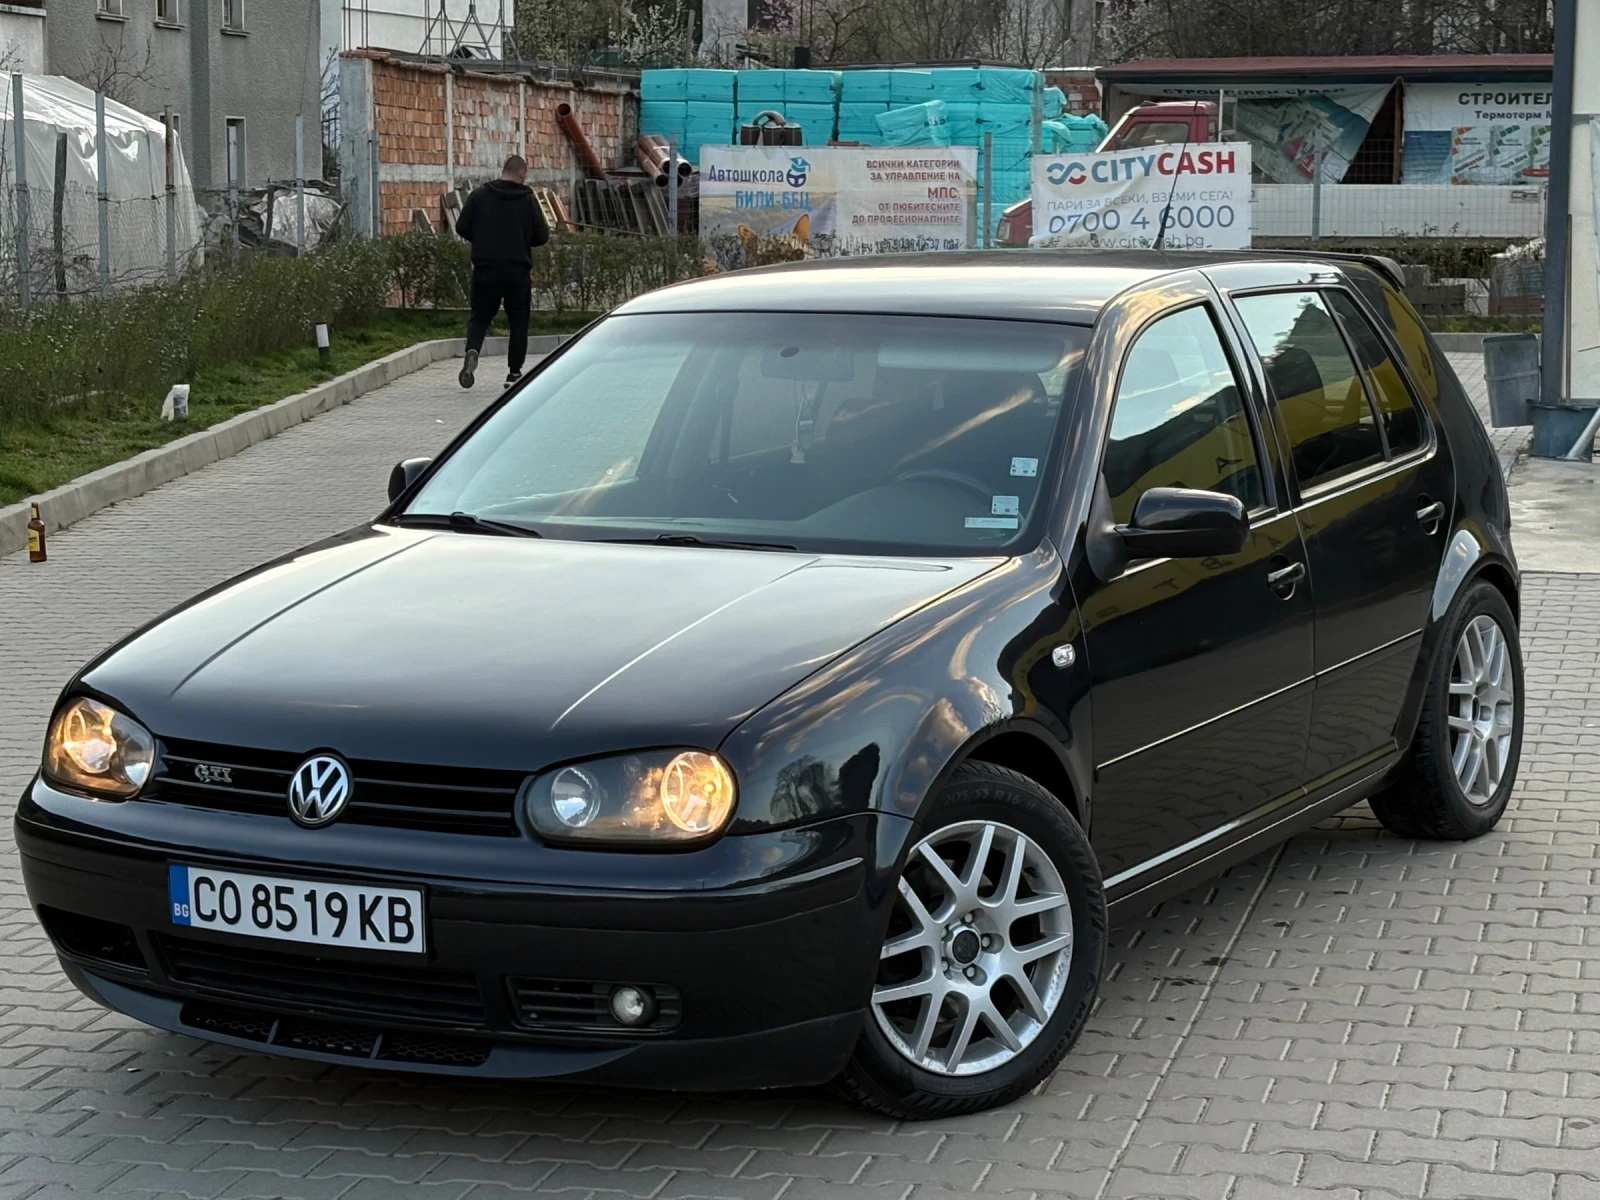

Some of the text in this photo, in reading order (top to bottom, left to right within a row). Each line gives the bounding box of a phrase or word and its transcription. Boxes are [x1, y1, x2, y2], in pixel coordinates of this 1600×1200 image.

[1474, 110, 1542, 121] Термотерм
[708, 164, 784, 183] Автошкола
[866, 160, 960, 169] ВСИЧКИ КАТЕГОРИИ
[1091, 151, 1235, 183] CITYCASH
[870, 171, 960, 181] ЗА УПРАВЛЕНИЕ НА
[878, 203, 890, 211] ОТ
[1047, 201, 1082, 211] ПАРИ
[1086, 199, 1100, 209] ЗА
[1104, 193, 1149, 208] ВСЕКИ,
[1199, 190, 1233, 202] СЕГА!
[852, 215, 960, 224] ДО ПРОФЕСИОНАЛНИТЕ
[1048, 205, 1235, 234] 0700 4 6000
[194, 764, 233, 783] GTI
[943, 788, 990, 808] 205/55
[173, 902, 190, 918] BG
[251, 883, 349, 938] 8519
[358, 893, 415, 945] KB
